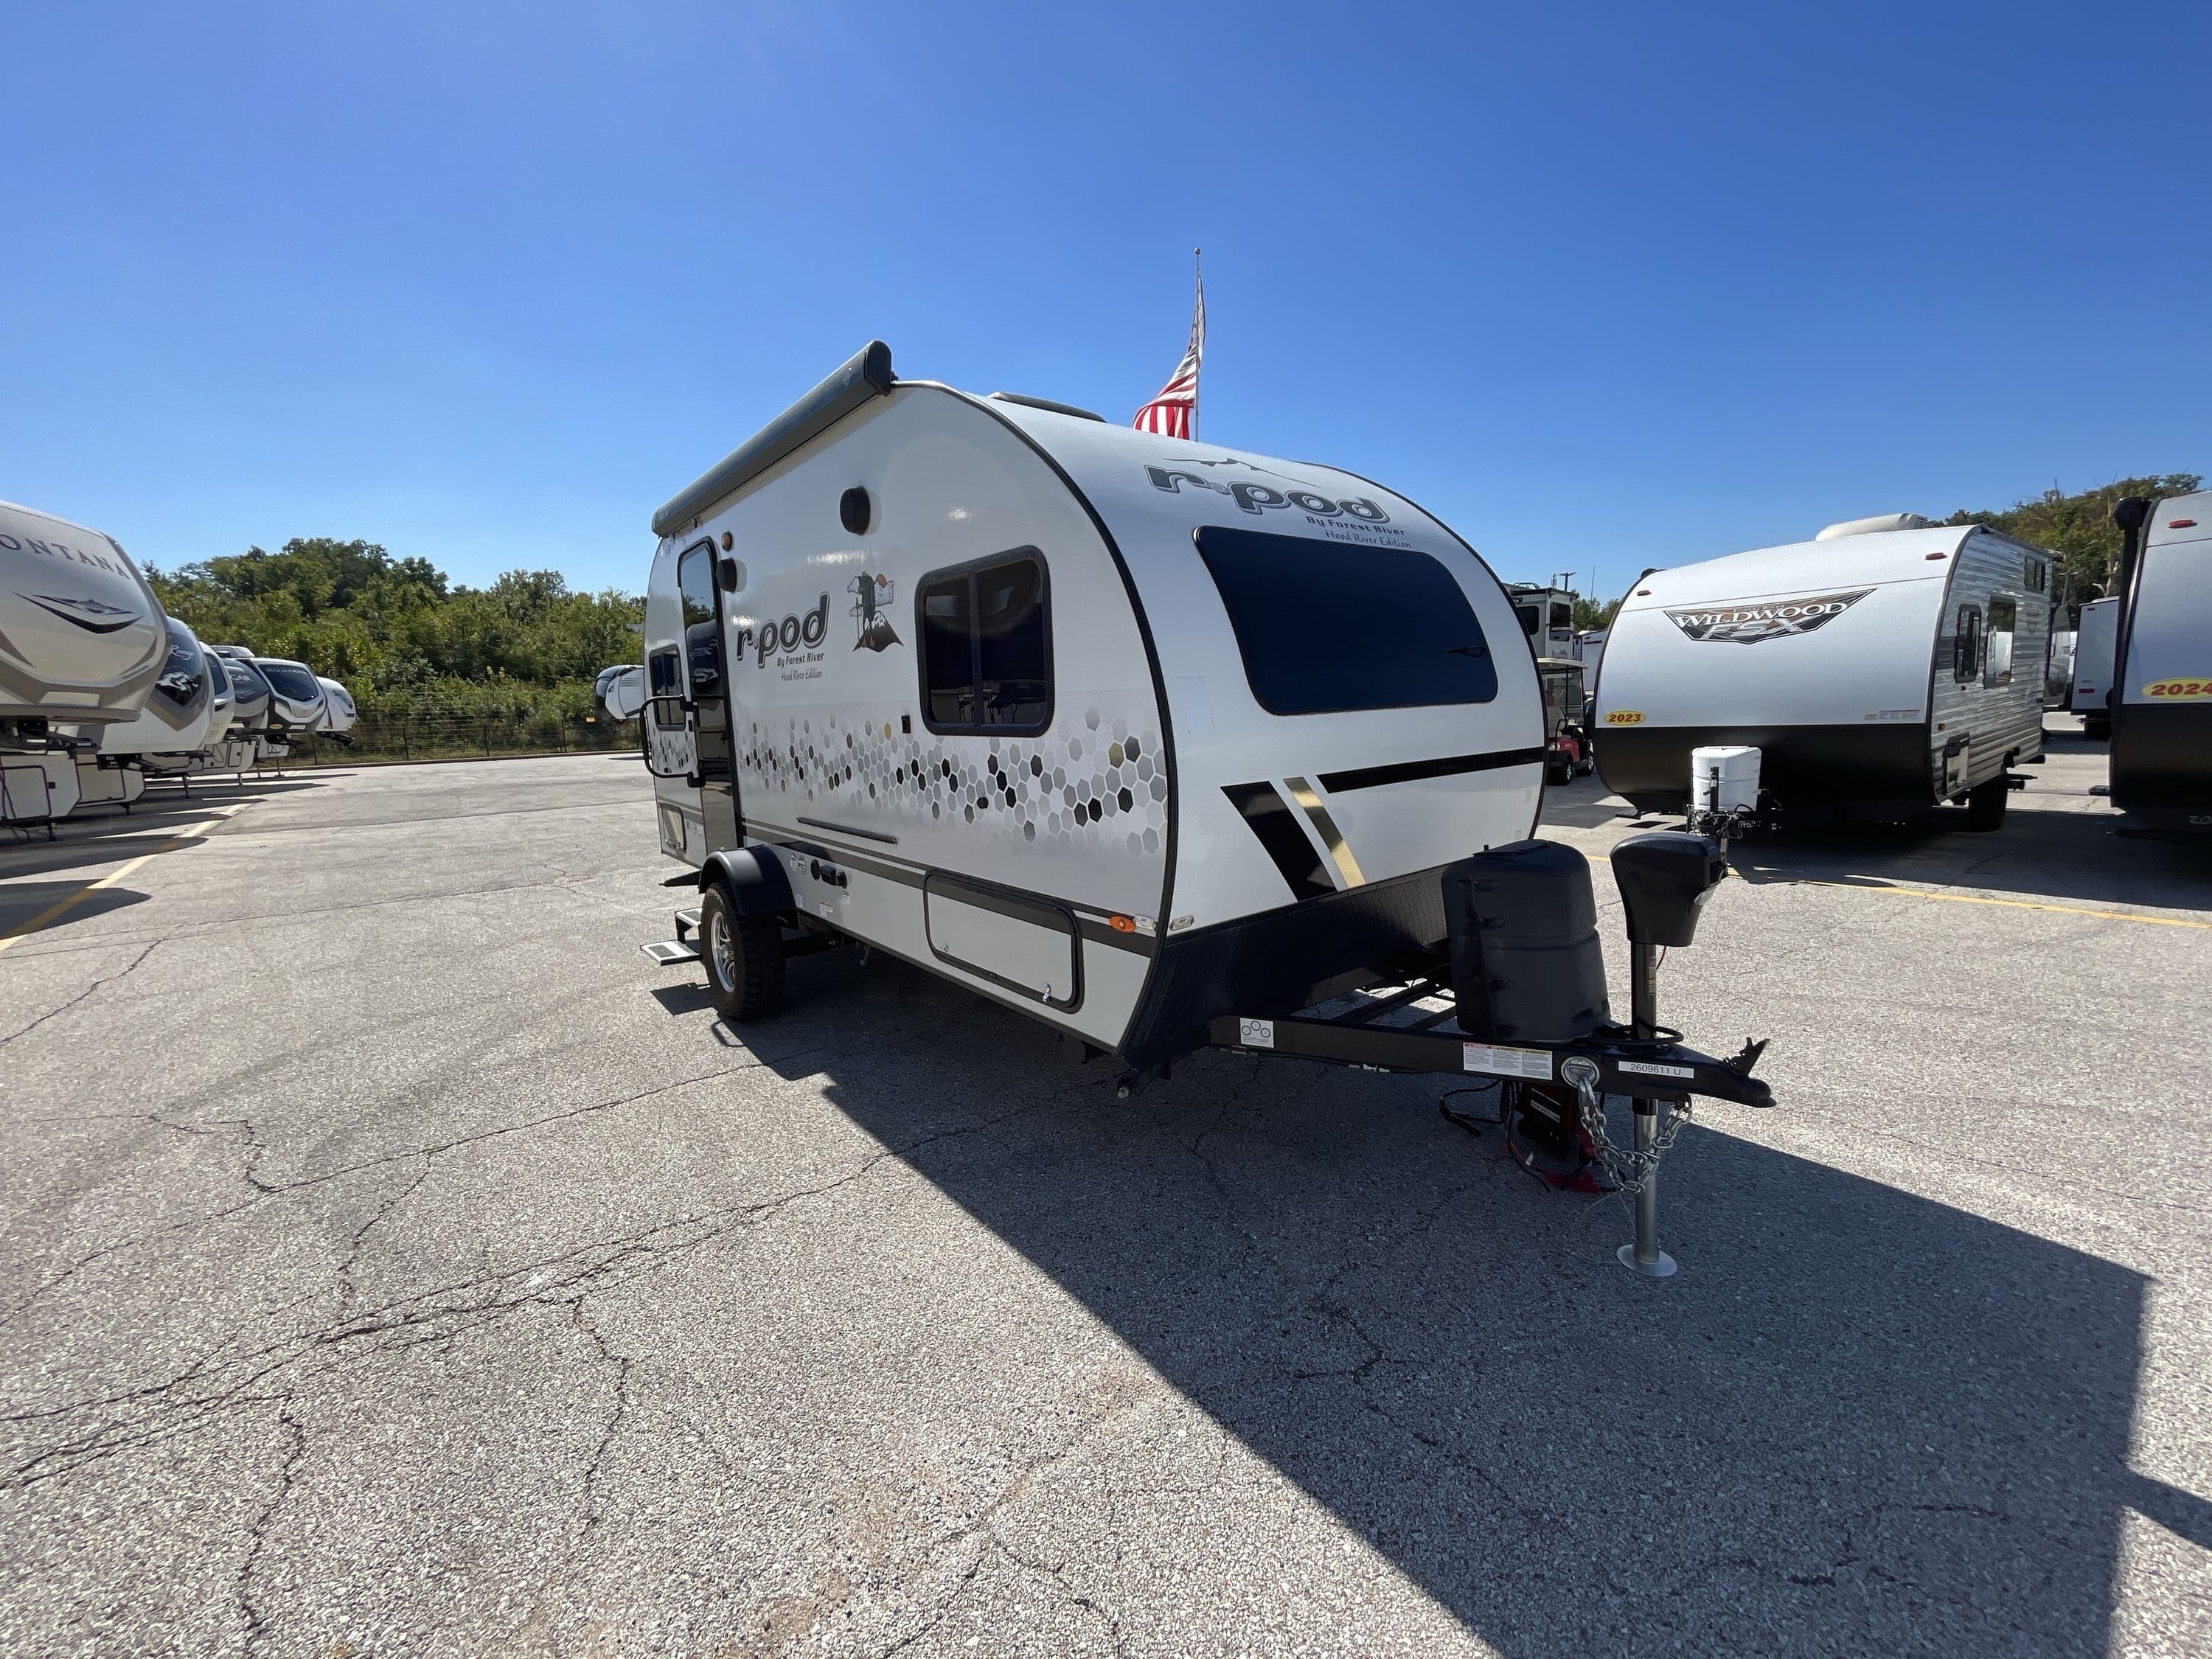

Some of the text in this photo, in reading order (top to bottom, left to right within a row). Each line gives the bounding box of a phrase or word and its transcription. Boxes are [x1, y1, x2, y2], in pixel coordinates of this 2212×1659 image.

[1307, 516, 1405, 536] By Forest River
[1325, 529, 1411, 549] Hood River Edition
[0, 533, 131, 580] ONTANA
[1674, 602, 1848, 627] WILDWOOD
[1700, 616, 1815, 640] FSX
[777, 652, 824, 668] By Forest River
[805, 667, 823, 679] Edition
[2151, 683, 2212, 696] 2024
[1609, 713, 1641, 723] 2023
[1630, 1062, 1681, 1076] 2609611 U
